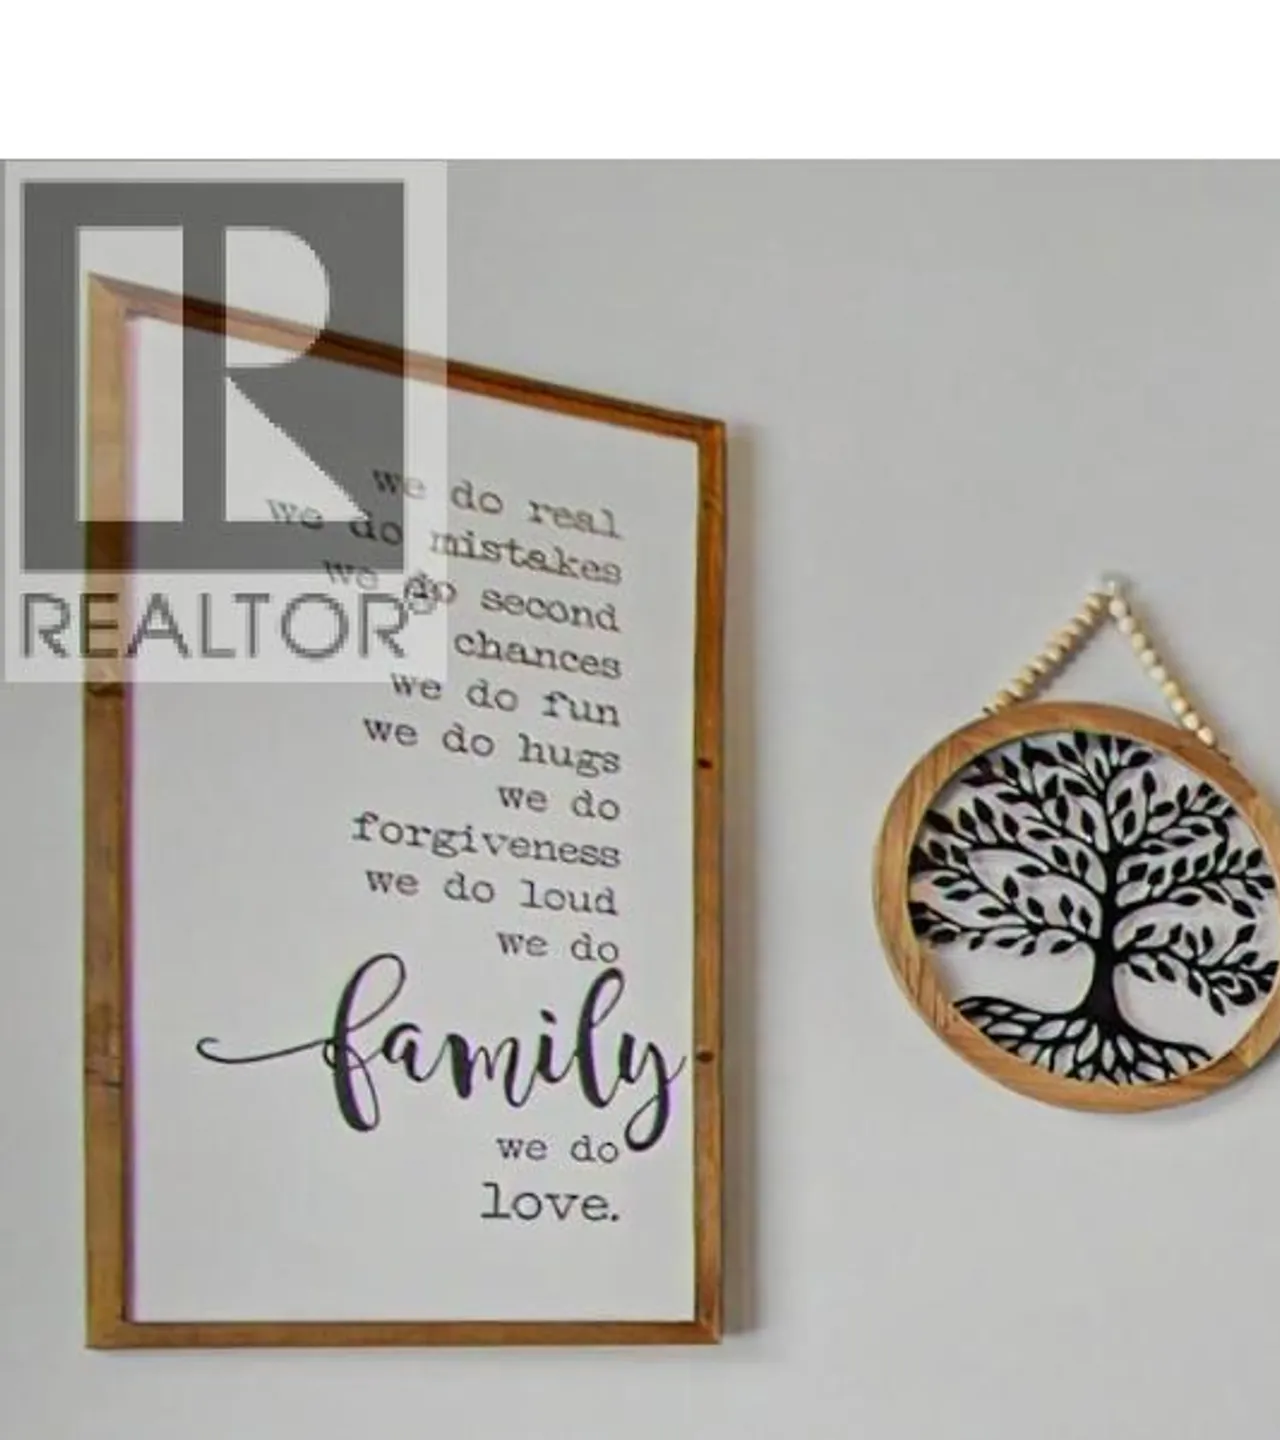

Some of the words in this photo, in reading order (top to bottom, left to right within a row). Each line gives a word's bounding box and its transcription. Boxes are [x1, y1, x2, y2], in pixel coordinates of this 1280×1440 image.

[371, 468, 427, 500] we
[449, 479, 504, 514] do
[527, 498, 623, 540] real
[264, 497, 325, 532] we
[348, 509, 402, 546] do
[428, 527, 623, 584] mistakes
[322, 557, 380, 590] we
[479, 586, 622, 632] second
[453, 629, 623, 680] chances
[389, 672, 443, 701] we
[465, 681, 519, 713] do
[540, 690, 622, 727] fun
[362, 717, 419, 747] we
[441, 723, 496, 757] do
[516, 733, 622, 778] hugs
[496, 784, 549, 813] we
[569, 789, 622, 822] do
[350, 810, 622, 868] forgiveness
[364, 868, 420, 896] we
[442, 871, 496, 904] do
[518, 879, 620, 916] loud
[496, 930, 550, 958] we
[568, 932, 620, 964] do
[197, 952, 686, 1152] family
[495, 1135, 549, 1162] we
[568, 1134, 621, 1164] do
[479, 1181, 622, 1223] love.
